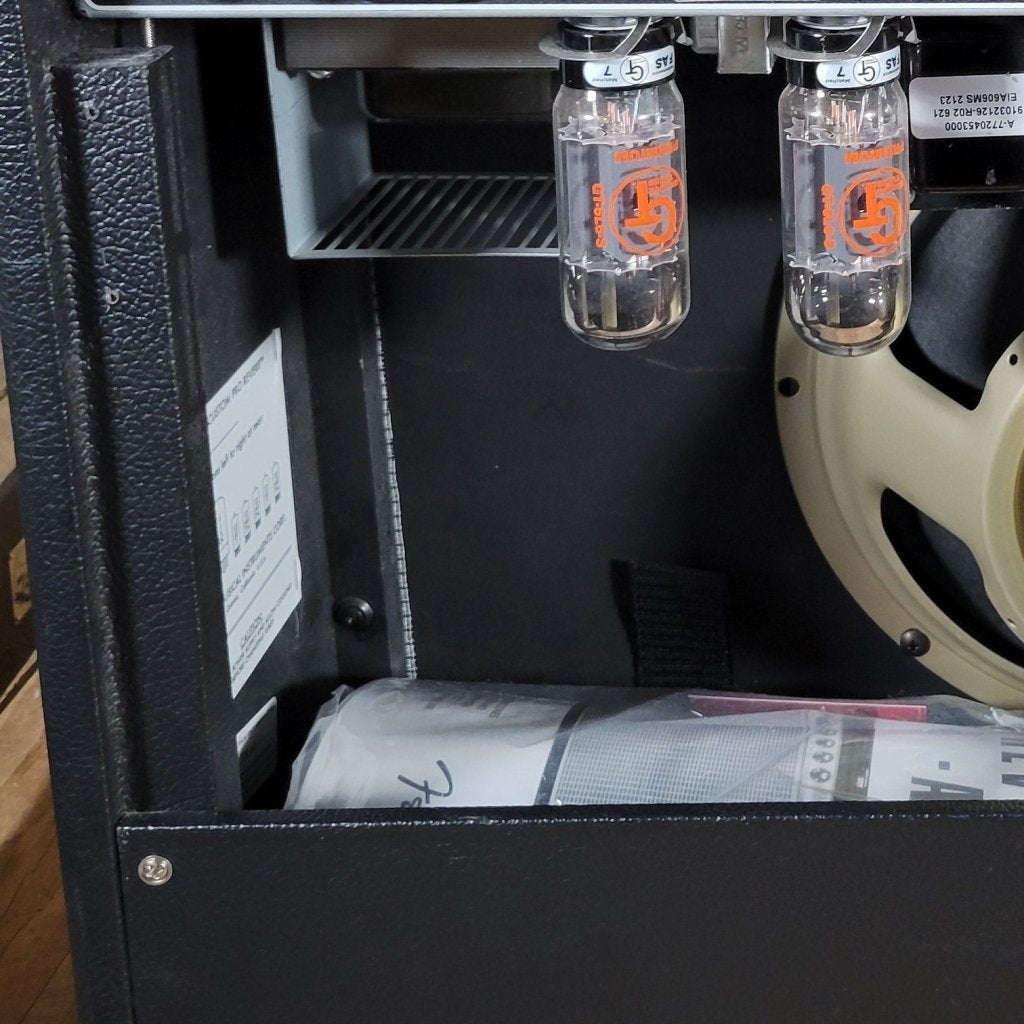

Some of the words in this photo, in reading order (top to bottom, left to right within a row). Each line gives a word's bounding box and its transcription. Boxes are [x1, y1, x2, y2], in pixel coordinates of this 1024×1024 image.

[940, 95, 964, 105] 2123
[933, 109, 951, 118] 621
[954, 106, 1023, 117] 91032126-R02
[945, 120, 1015, 131] A-7720453000
